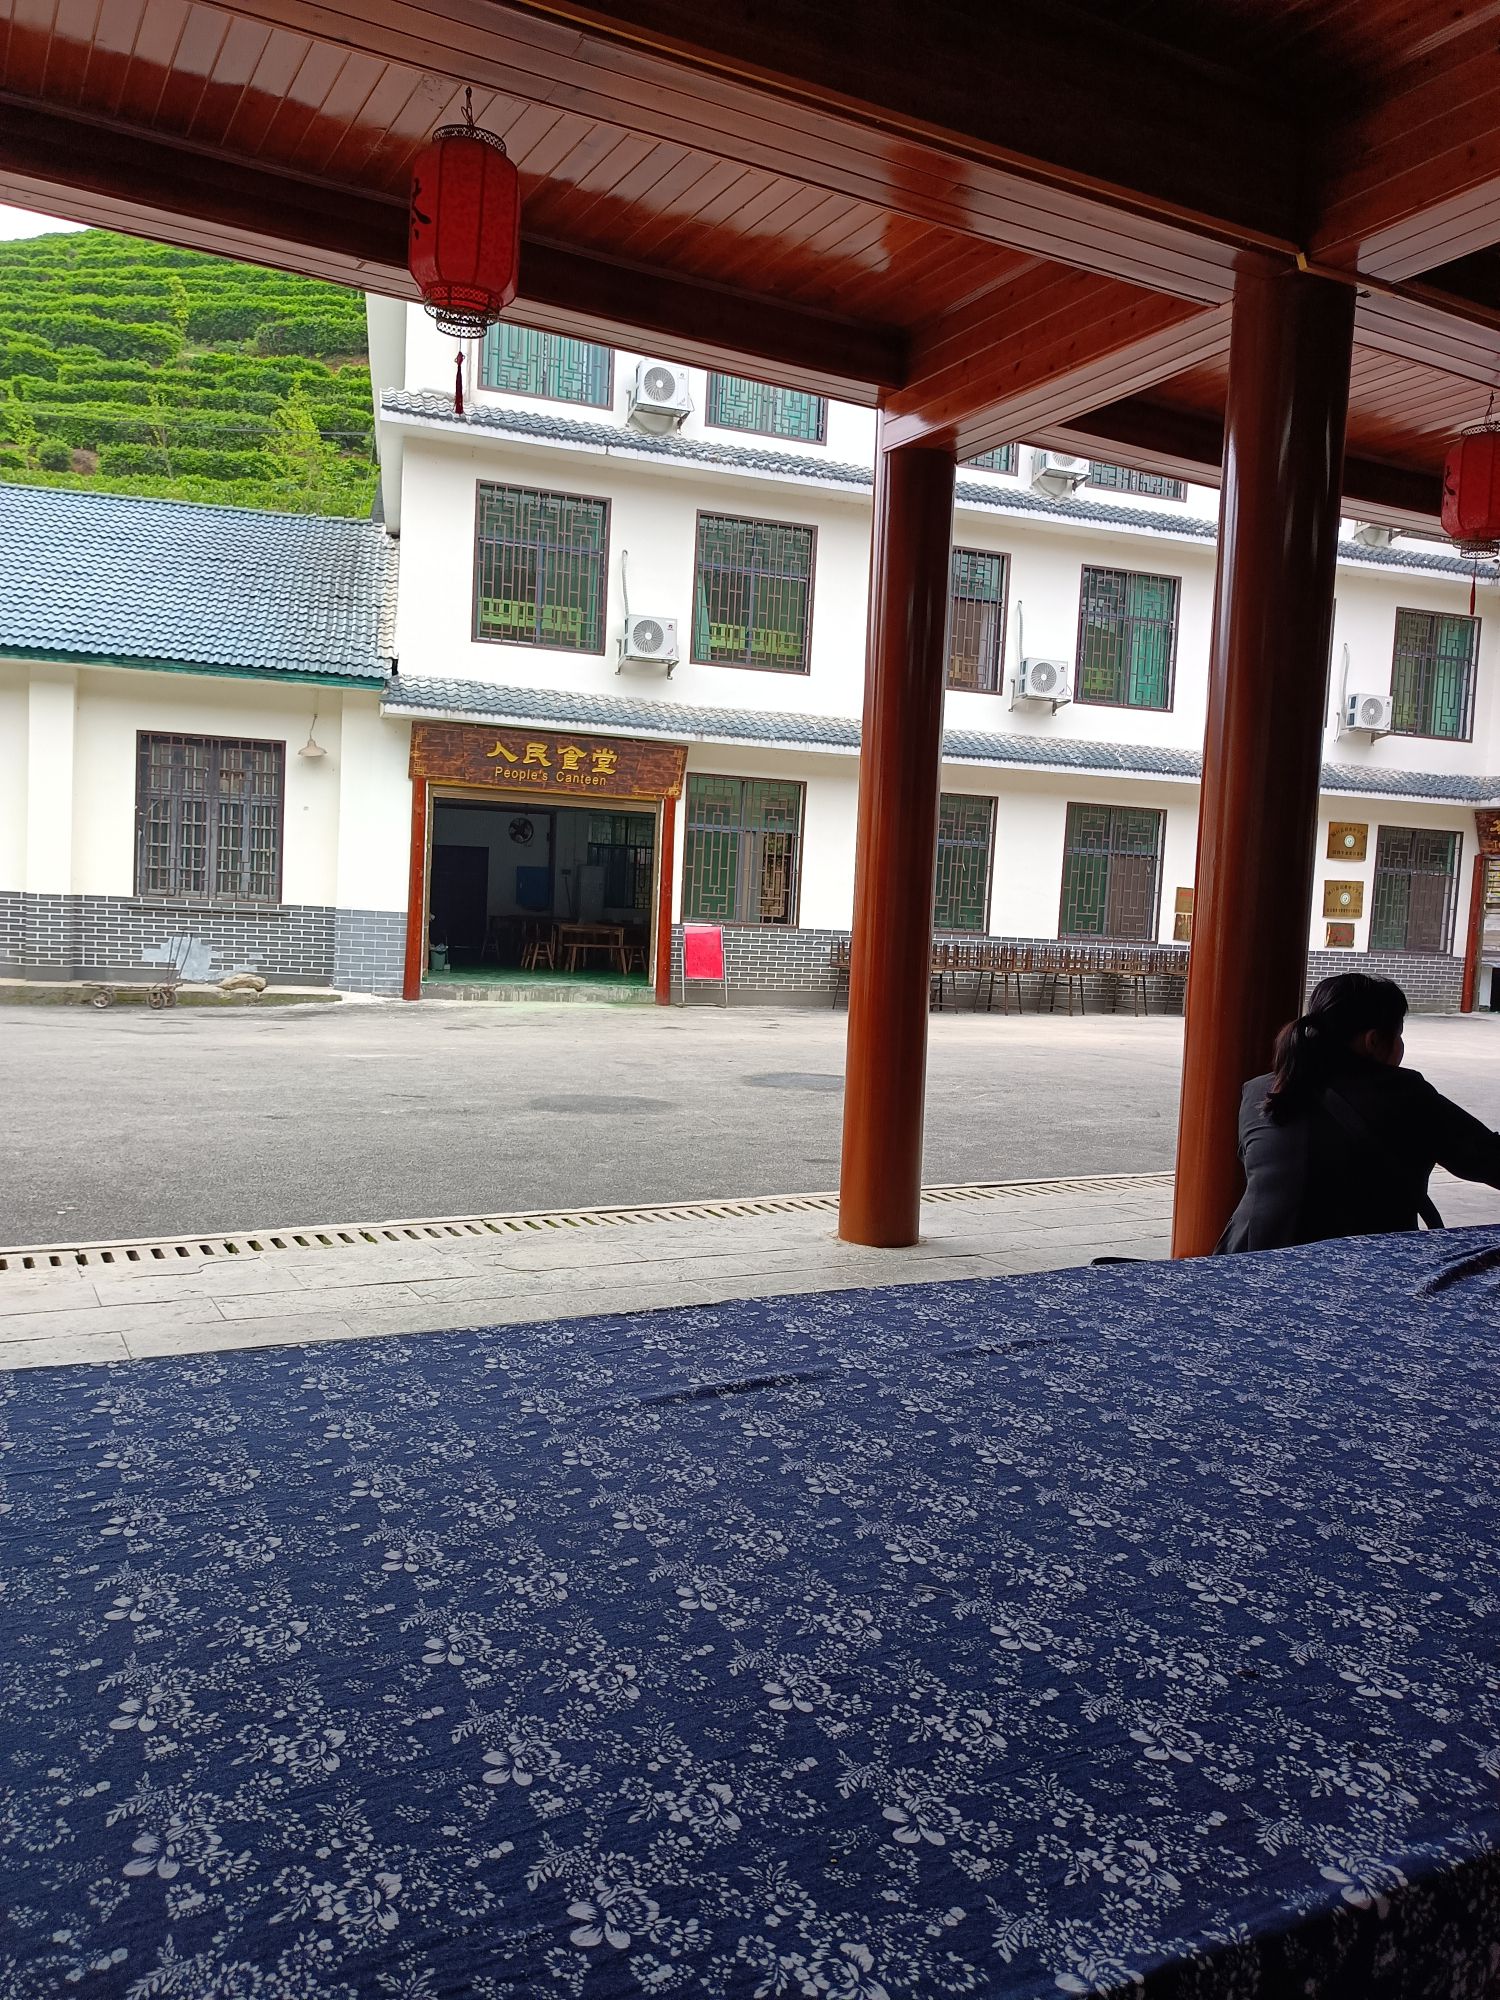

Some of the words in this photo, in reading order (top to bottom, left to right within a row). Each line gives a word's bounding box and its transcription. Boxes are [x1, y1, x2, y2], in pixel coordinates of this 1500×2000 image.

[487, 741, 618, 775] 人民食堂
[494, 766, 549, 782] People's
[555, 771, 607, 786] Canteen
